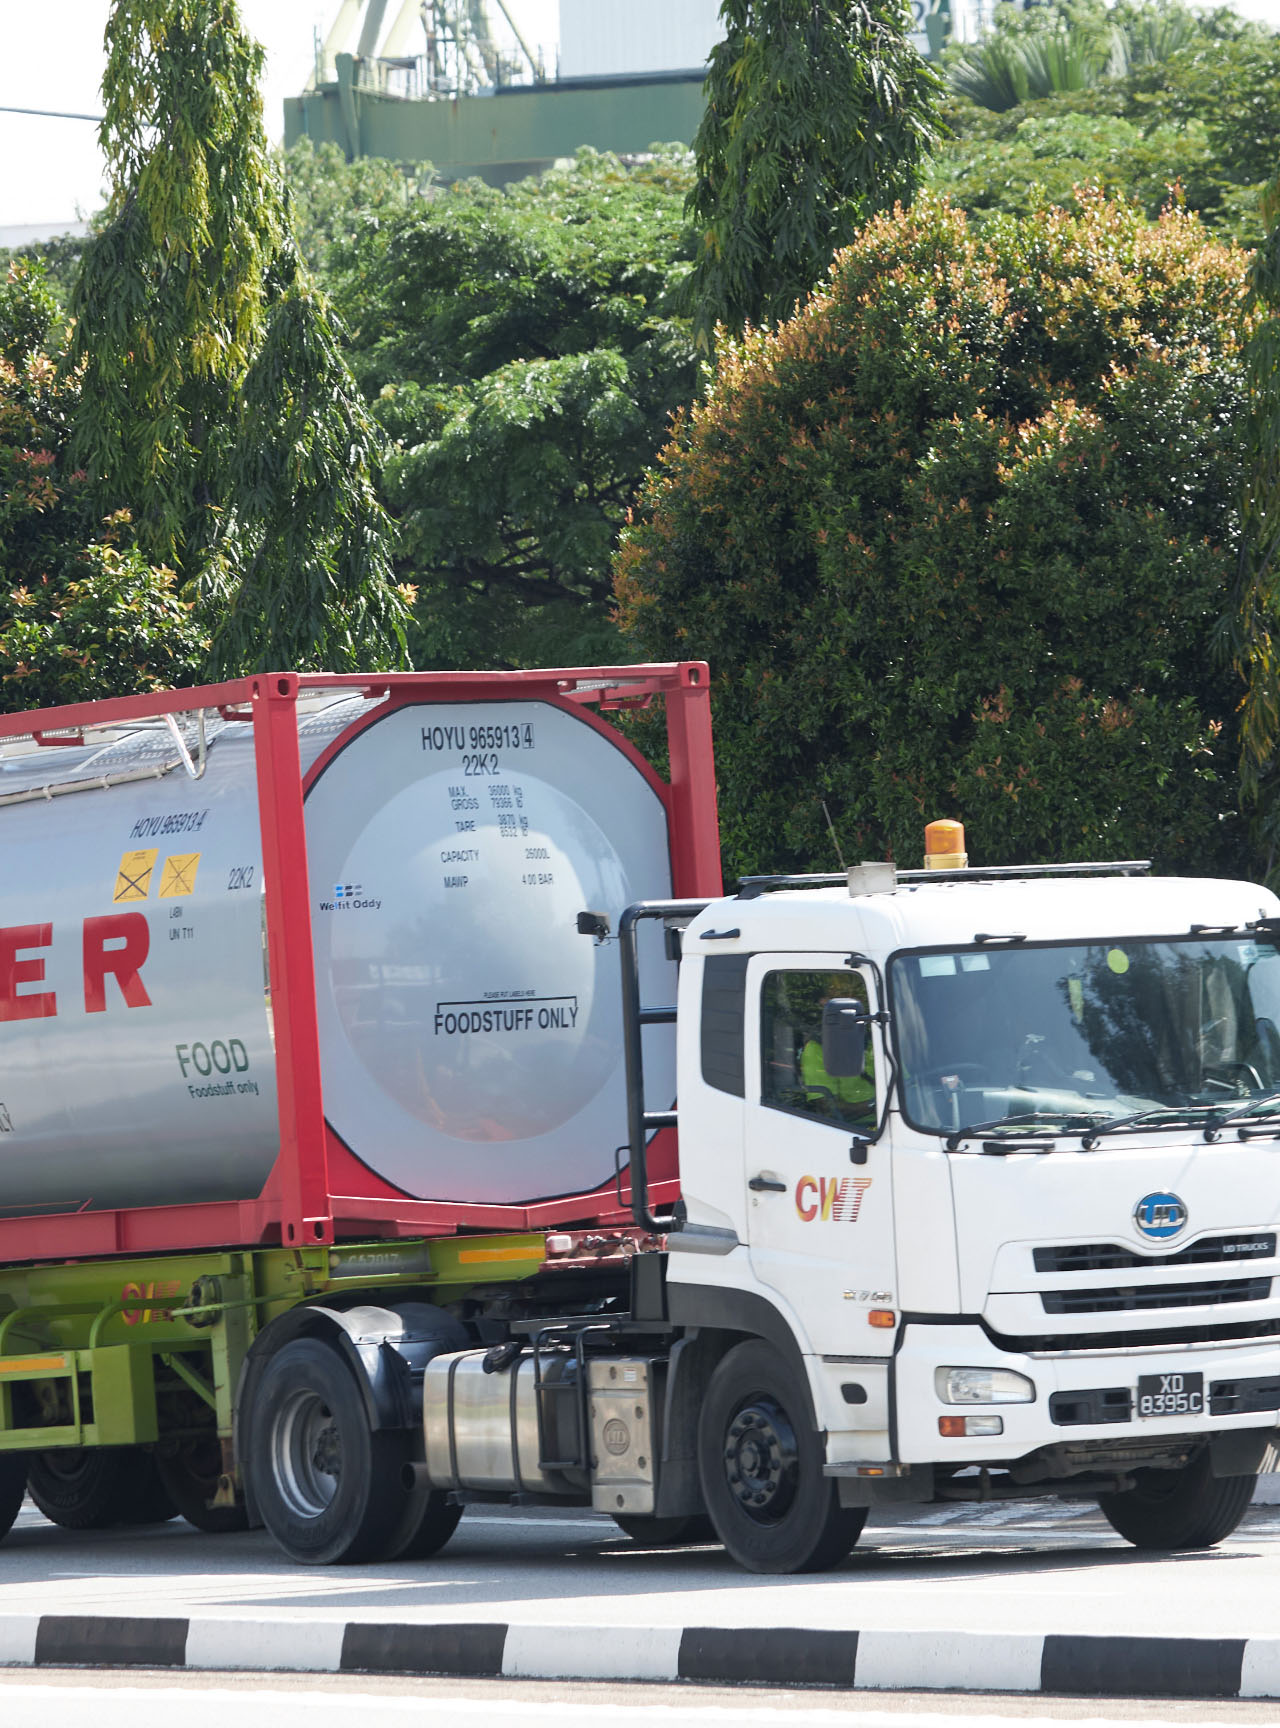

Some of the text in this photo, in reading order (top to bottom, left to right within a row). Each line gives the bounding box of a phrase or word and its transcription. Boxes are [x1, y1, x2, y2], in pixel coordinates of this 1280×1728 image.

[421, 726, 465, 750] HOYU
[470, 725, 520, 750] 965913
[462, 753, 500, 776] 22K2
[451, 798, 479, 811] GROSS
[129, 815, 165, 839] HOYU
[160, 811, 199, 835] 965913
[455, 820, 477, 833] TARE
[440, 849, 480, 863] CAPACITY
[227, 865, 254, 890] 22K2
[443, 875, 469, 889] MAWP
[319, 899, 382, 911] Welfit Oddy
[434, 1006, 579, 1035] FOODSTUFF ONLY
[175, 1038, 249, 1078] FOOD
[187, 1080, 260, 1099] Foodstuff only
[795, 1175, 873, 1222] CWT
[1223, 1241, 1269, 1254] UD TRUCKS
[1159, 1374, 1185, 1393] XD
[1140, 1390, 1203, 1415] 8395C
